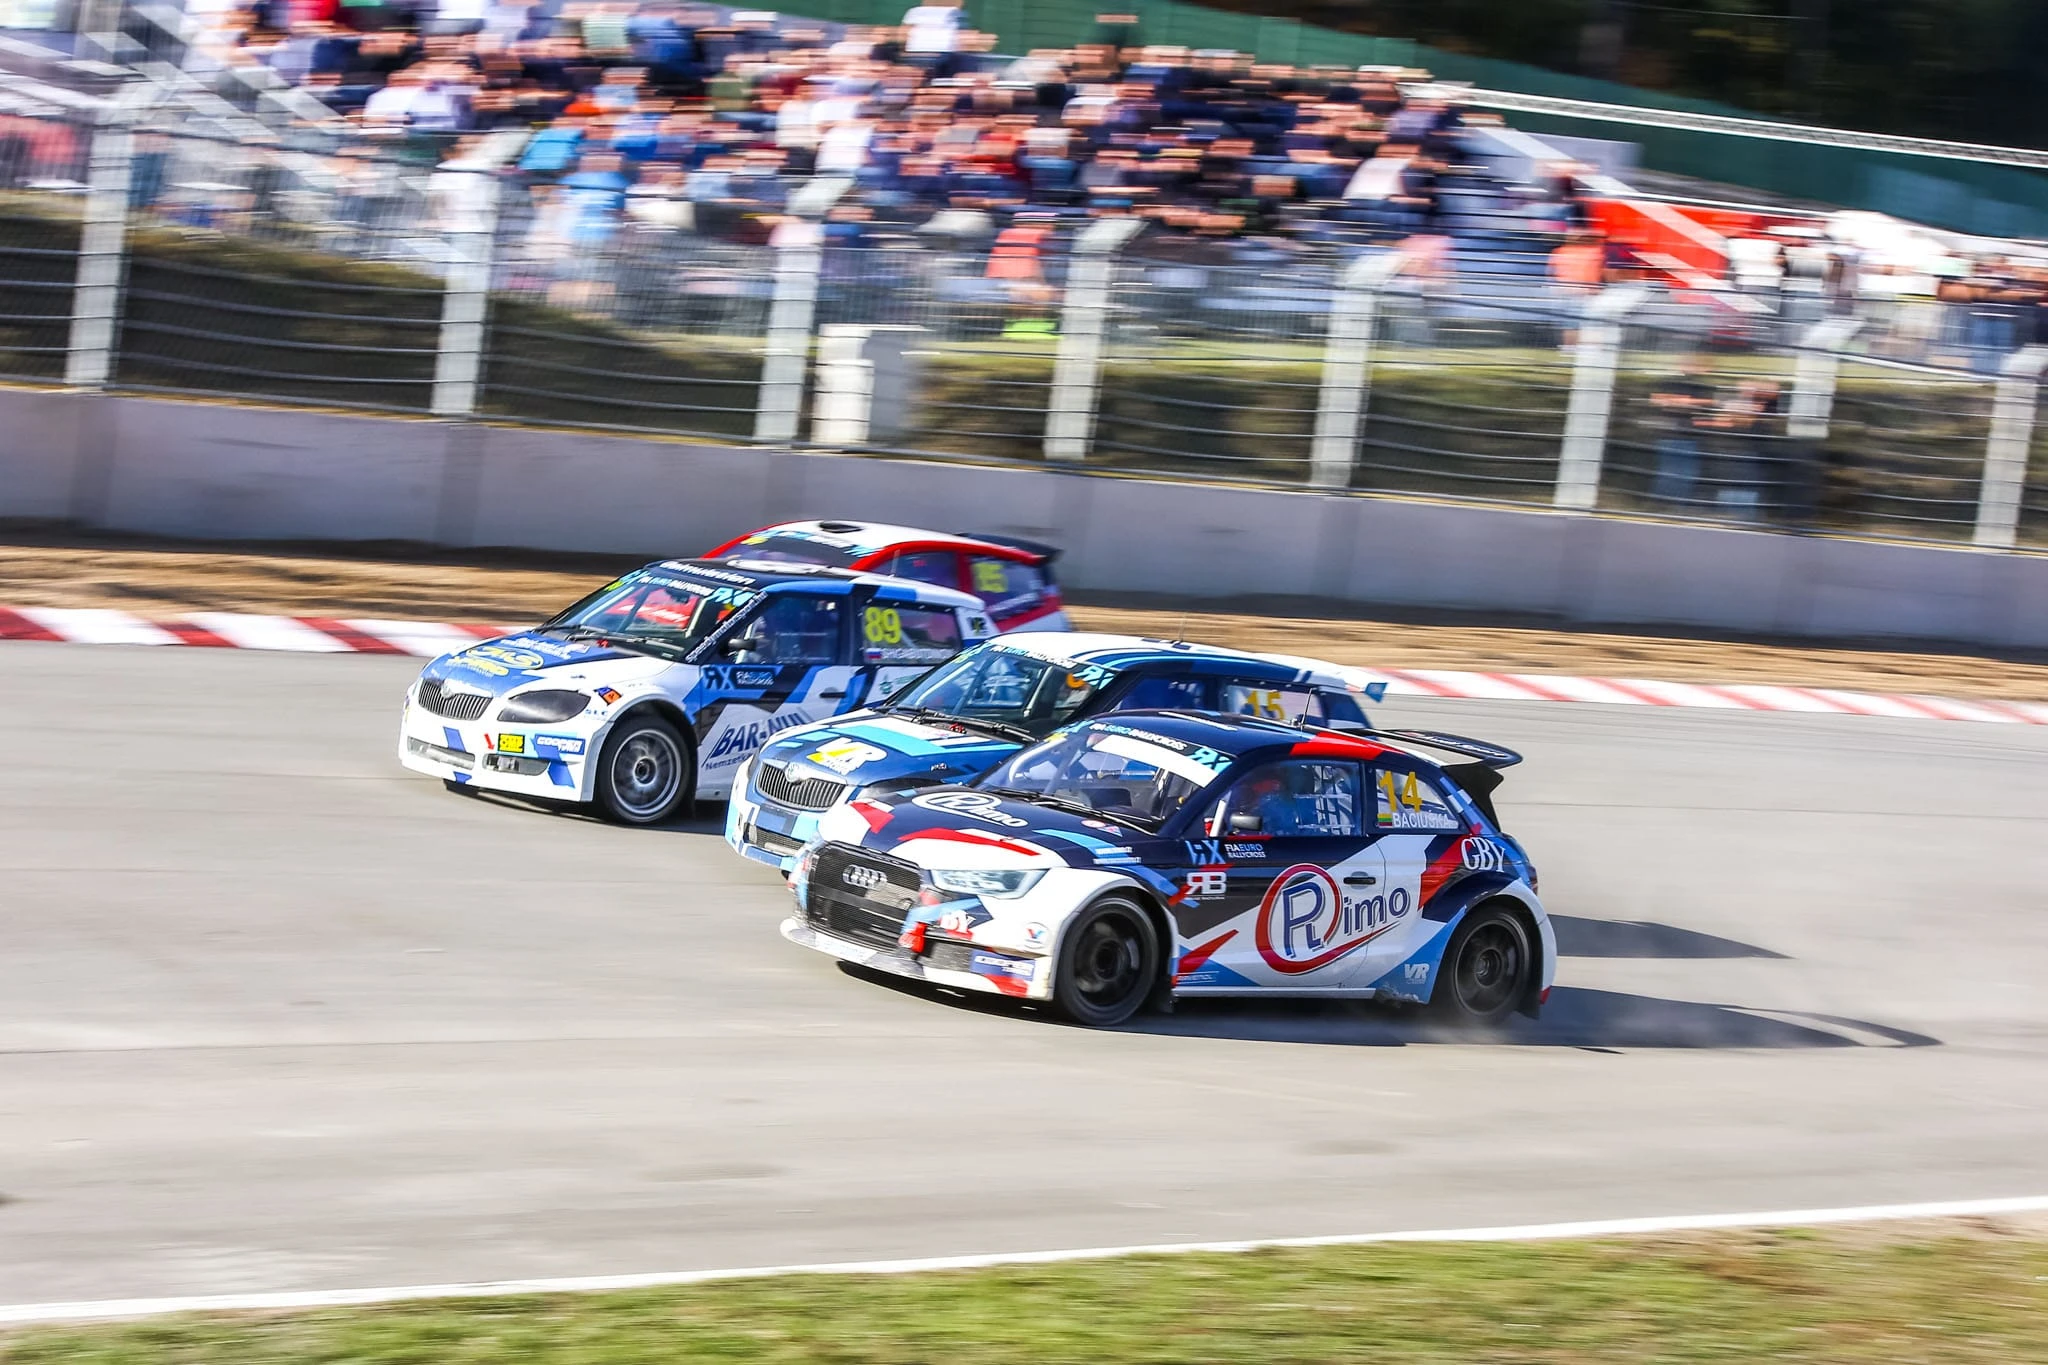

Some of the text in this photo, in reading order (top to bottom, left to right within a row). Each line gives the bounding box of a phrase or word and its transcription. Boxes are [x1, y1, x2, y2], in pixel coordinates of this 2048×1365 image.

[865, 606, 901, 644] 89
[1247, 690, 1285, 721] 15
[1379, 770, 1423, 813] 14
[1461, 837, 1506, 873] GBY
[1404, 963, 1430, 980] VR
